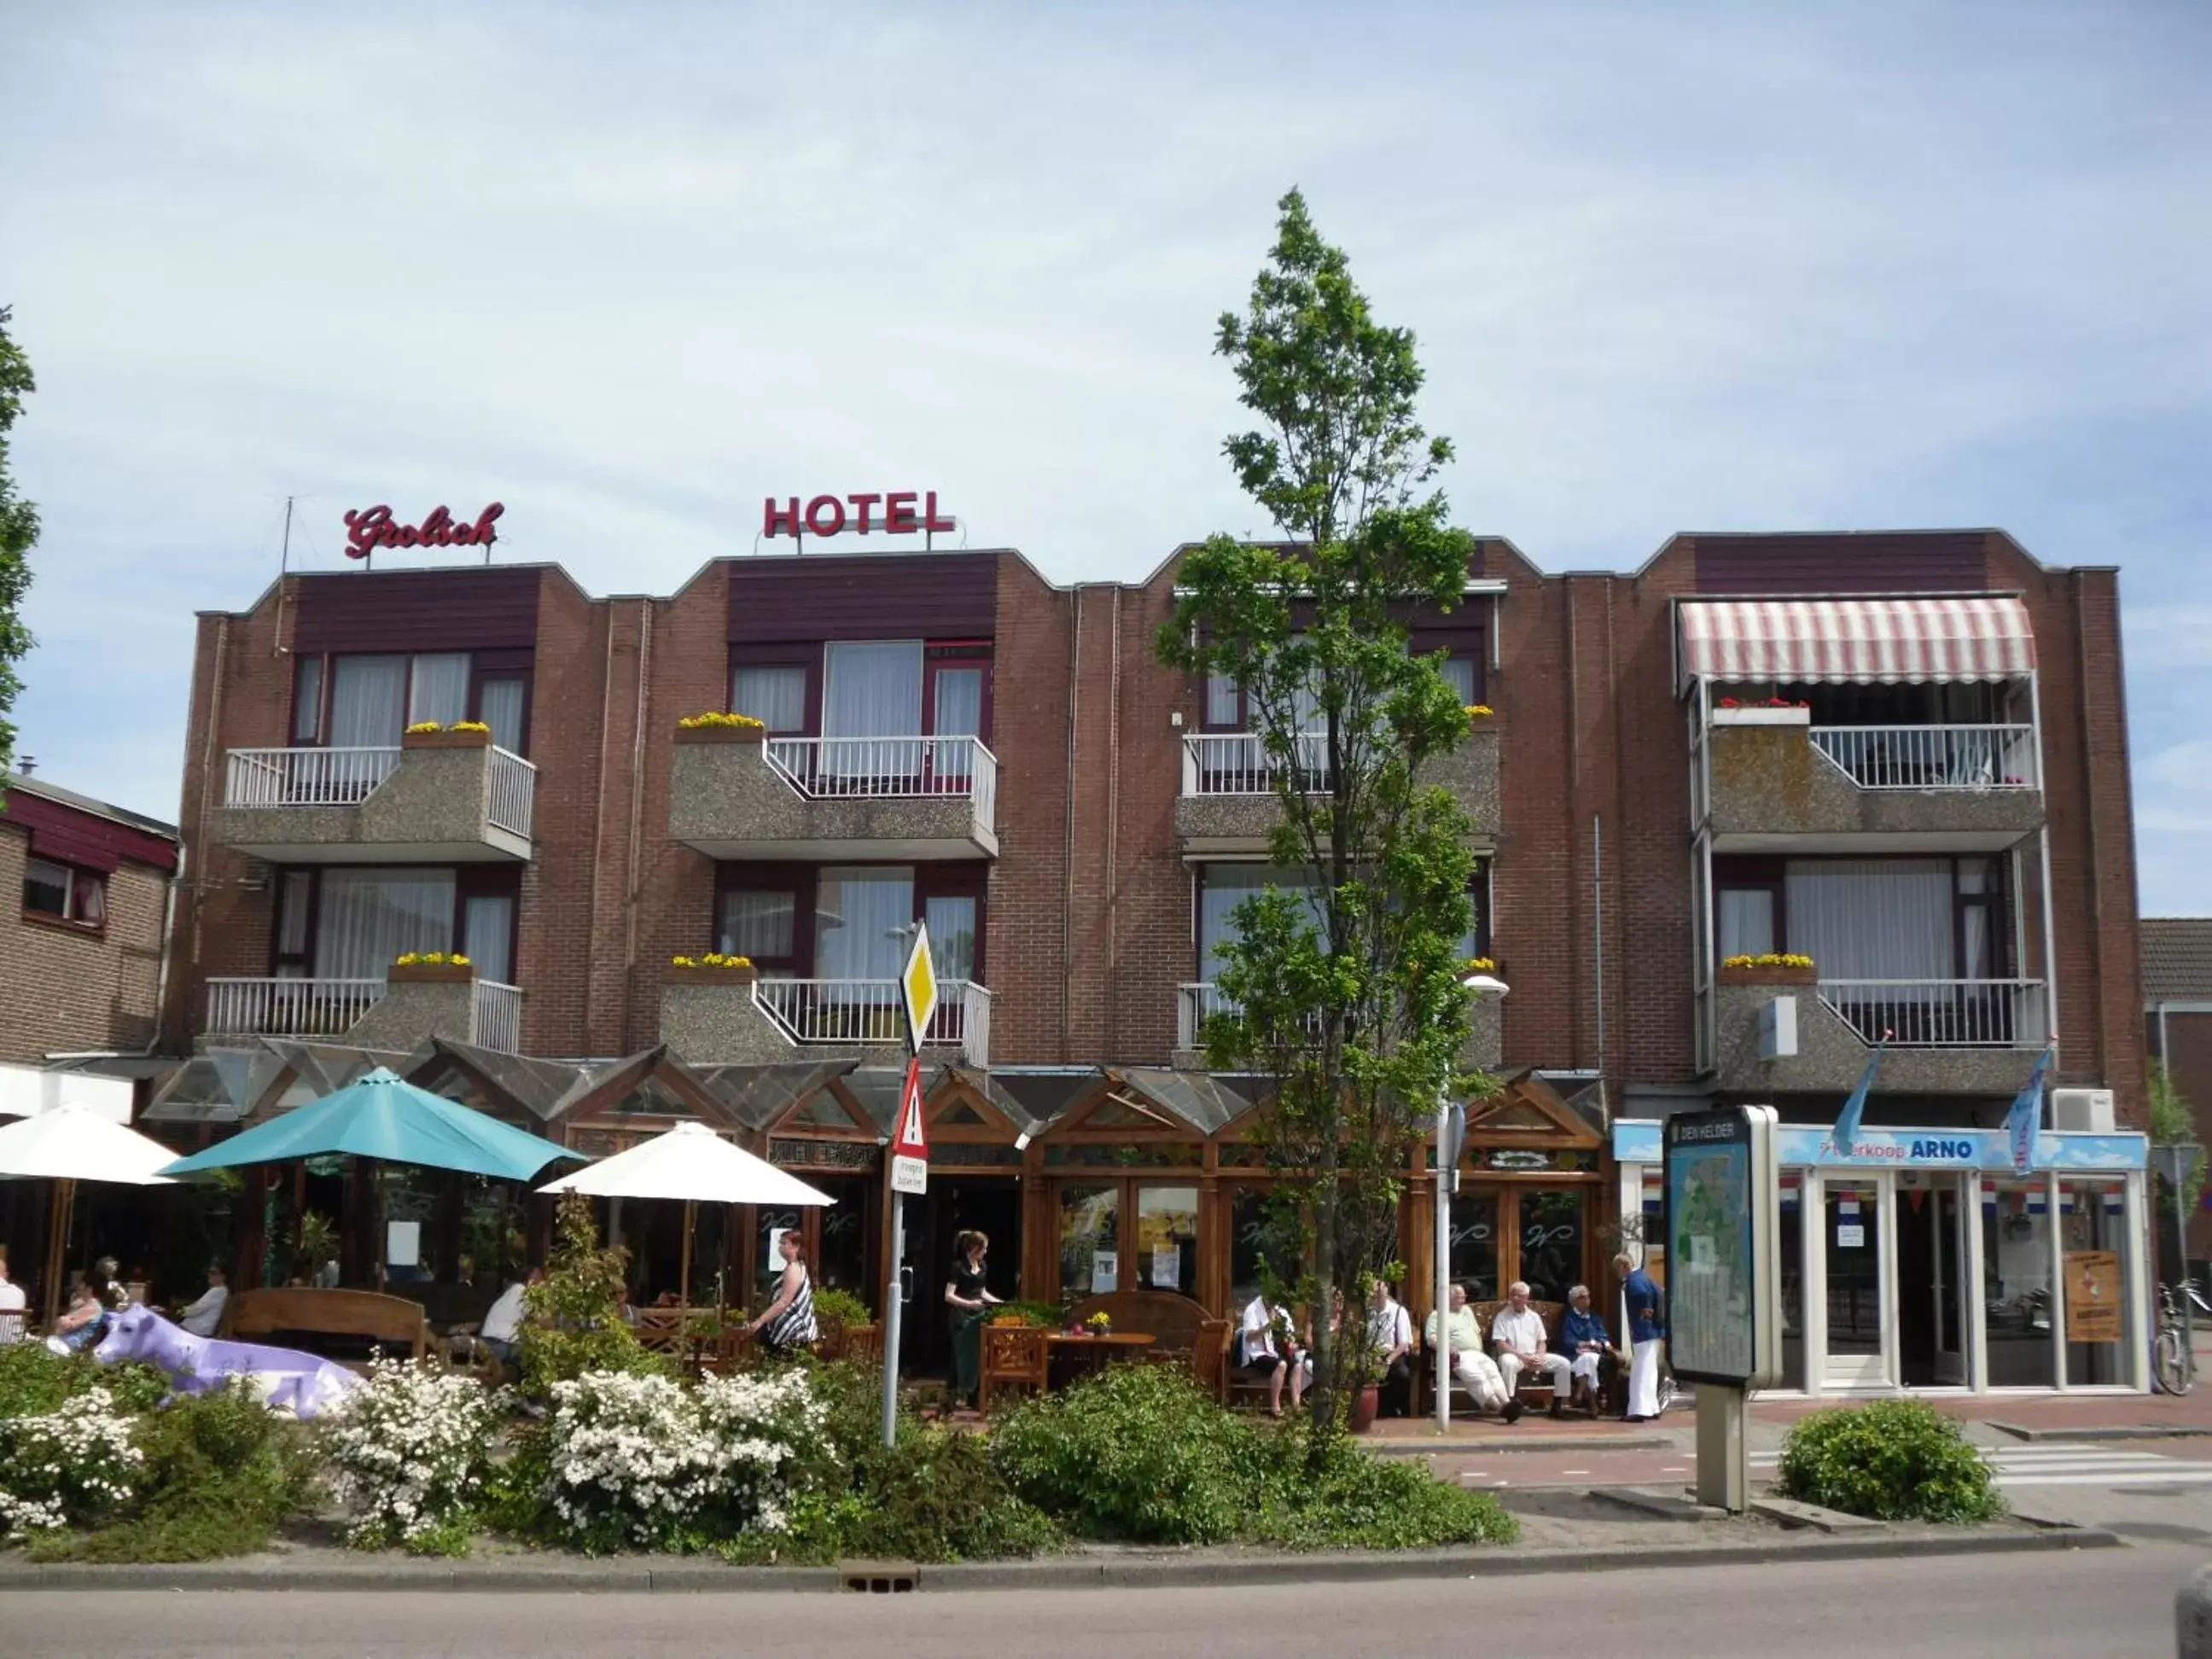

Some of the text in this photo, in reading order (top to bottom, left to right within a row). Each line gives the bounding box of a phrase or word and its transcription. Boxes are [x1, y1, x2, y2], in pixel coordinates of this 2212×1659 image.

[344, 502, 505, 560] Grolsch
[765, 492, 955, 538] HOTEL
[1911, 1140, 1972, 1159] ARNO
